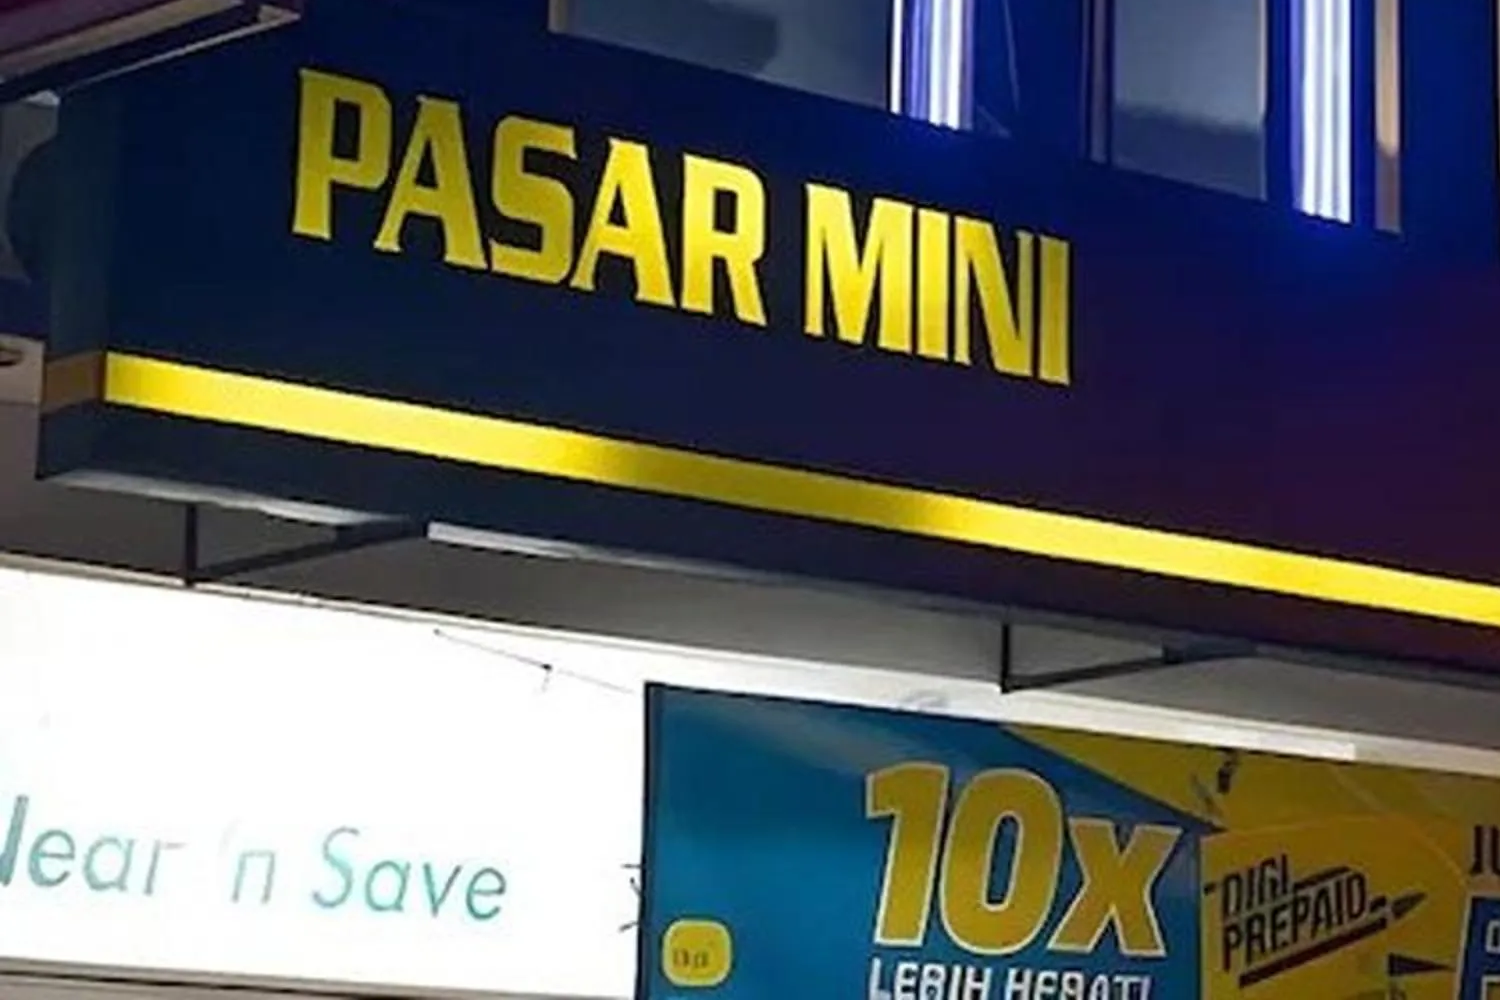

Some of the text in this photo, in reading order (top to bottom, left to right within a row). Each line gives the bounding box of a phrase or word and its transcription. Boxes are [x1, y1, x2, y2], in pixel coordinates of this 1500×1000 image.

[292, 68, 1071, 385] PASAR MINI
[312, 826, 508, 920] Save
[1222, 853, 1290, 920] DIGI
[1222, 872, 1366, 973] PREPAID
[869, 957, 992, 1000] LEBIH
